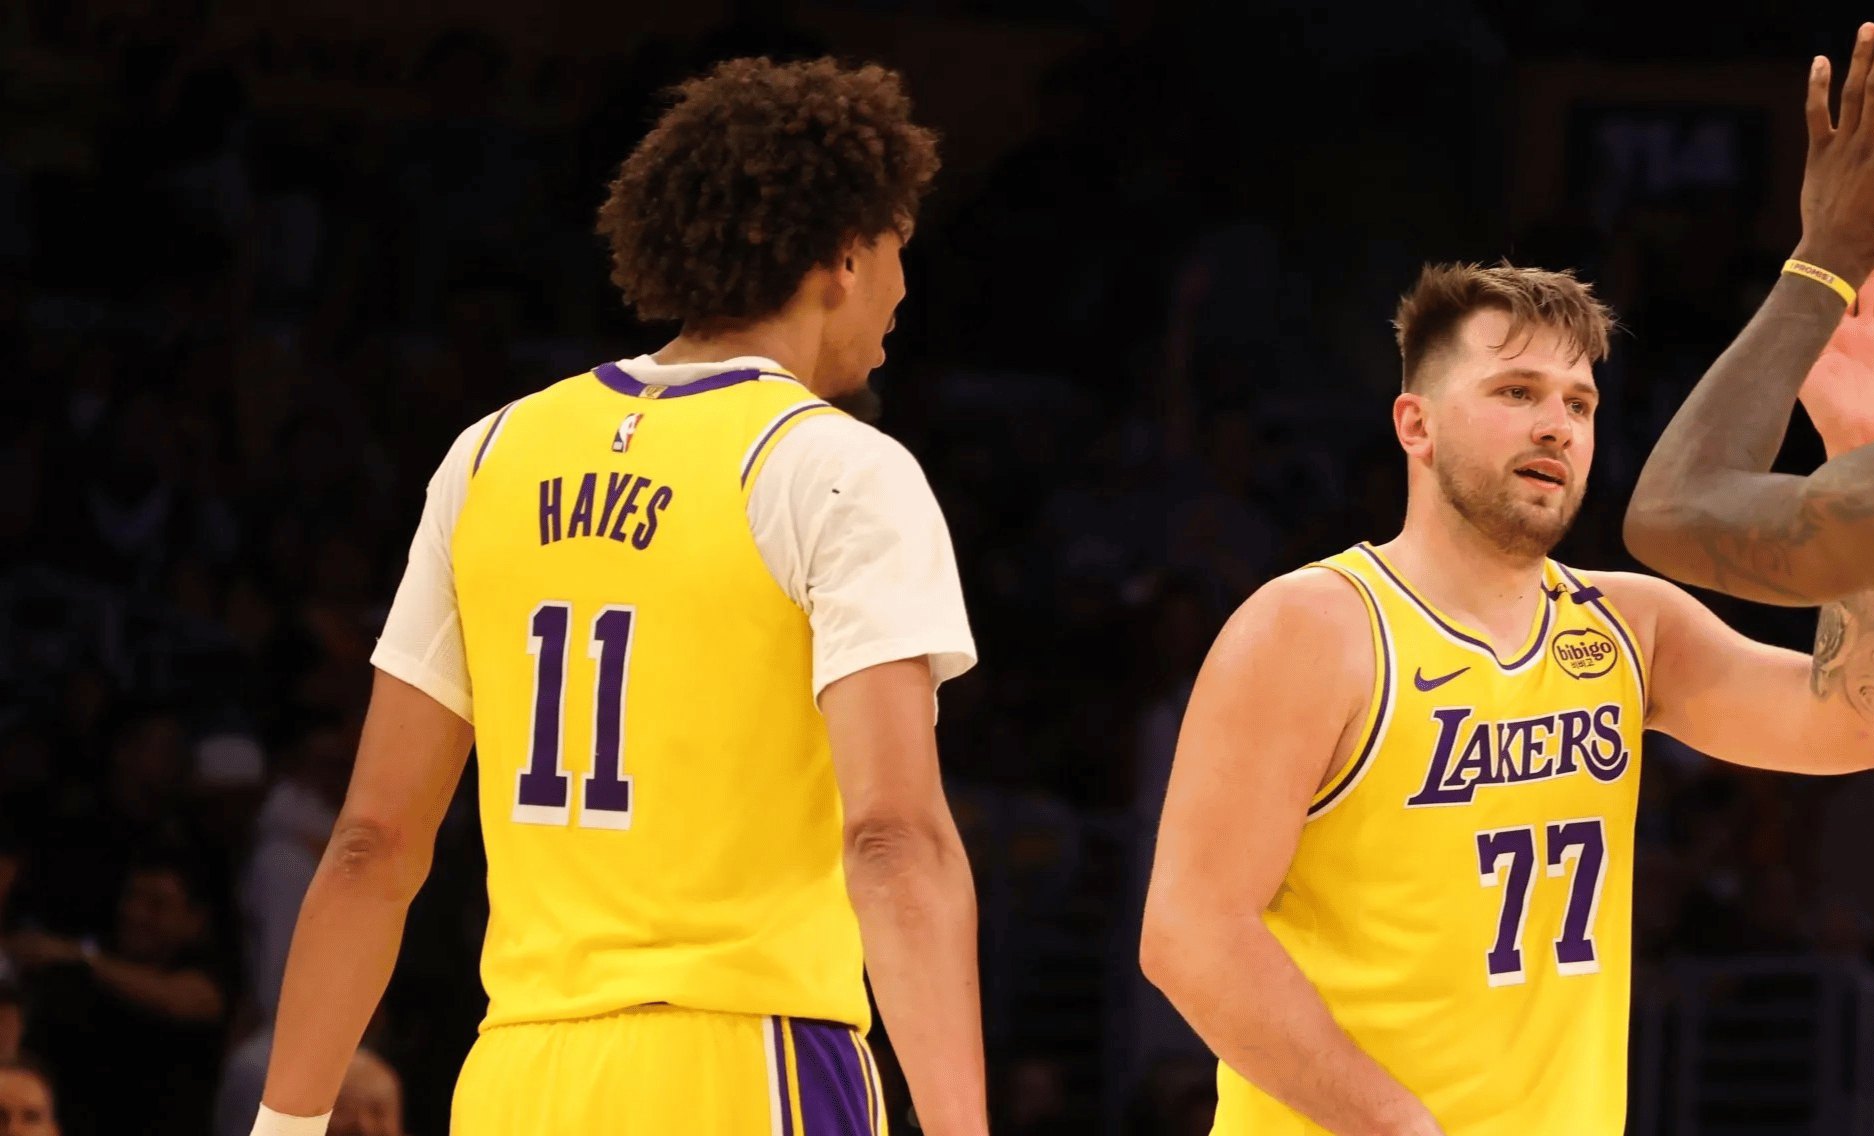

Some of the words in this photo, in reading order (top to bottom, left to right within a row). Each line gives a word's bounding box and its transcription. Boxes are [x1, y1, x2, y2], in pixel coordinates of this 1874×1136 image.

[539, 471, 673, 551] HAYES
[1556, 641, 1612, 661] bibigo
[511, 599, 637, 832] 11
[1405, 702, 1630, 808] LAKERS
[1474, 816, 1609, 988] 77
